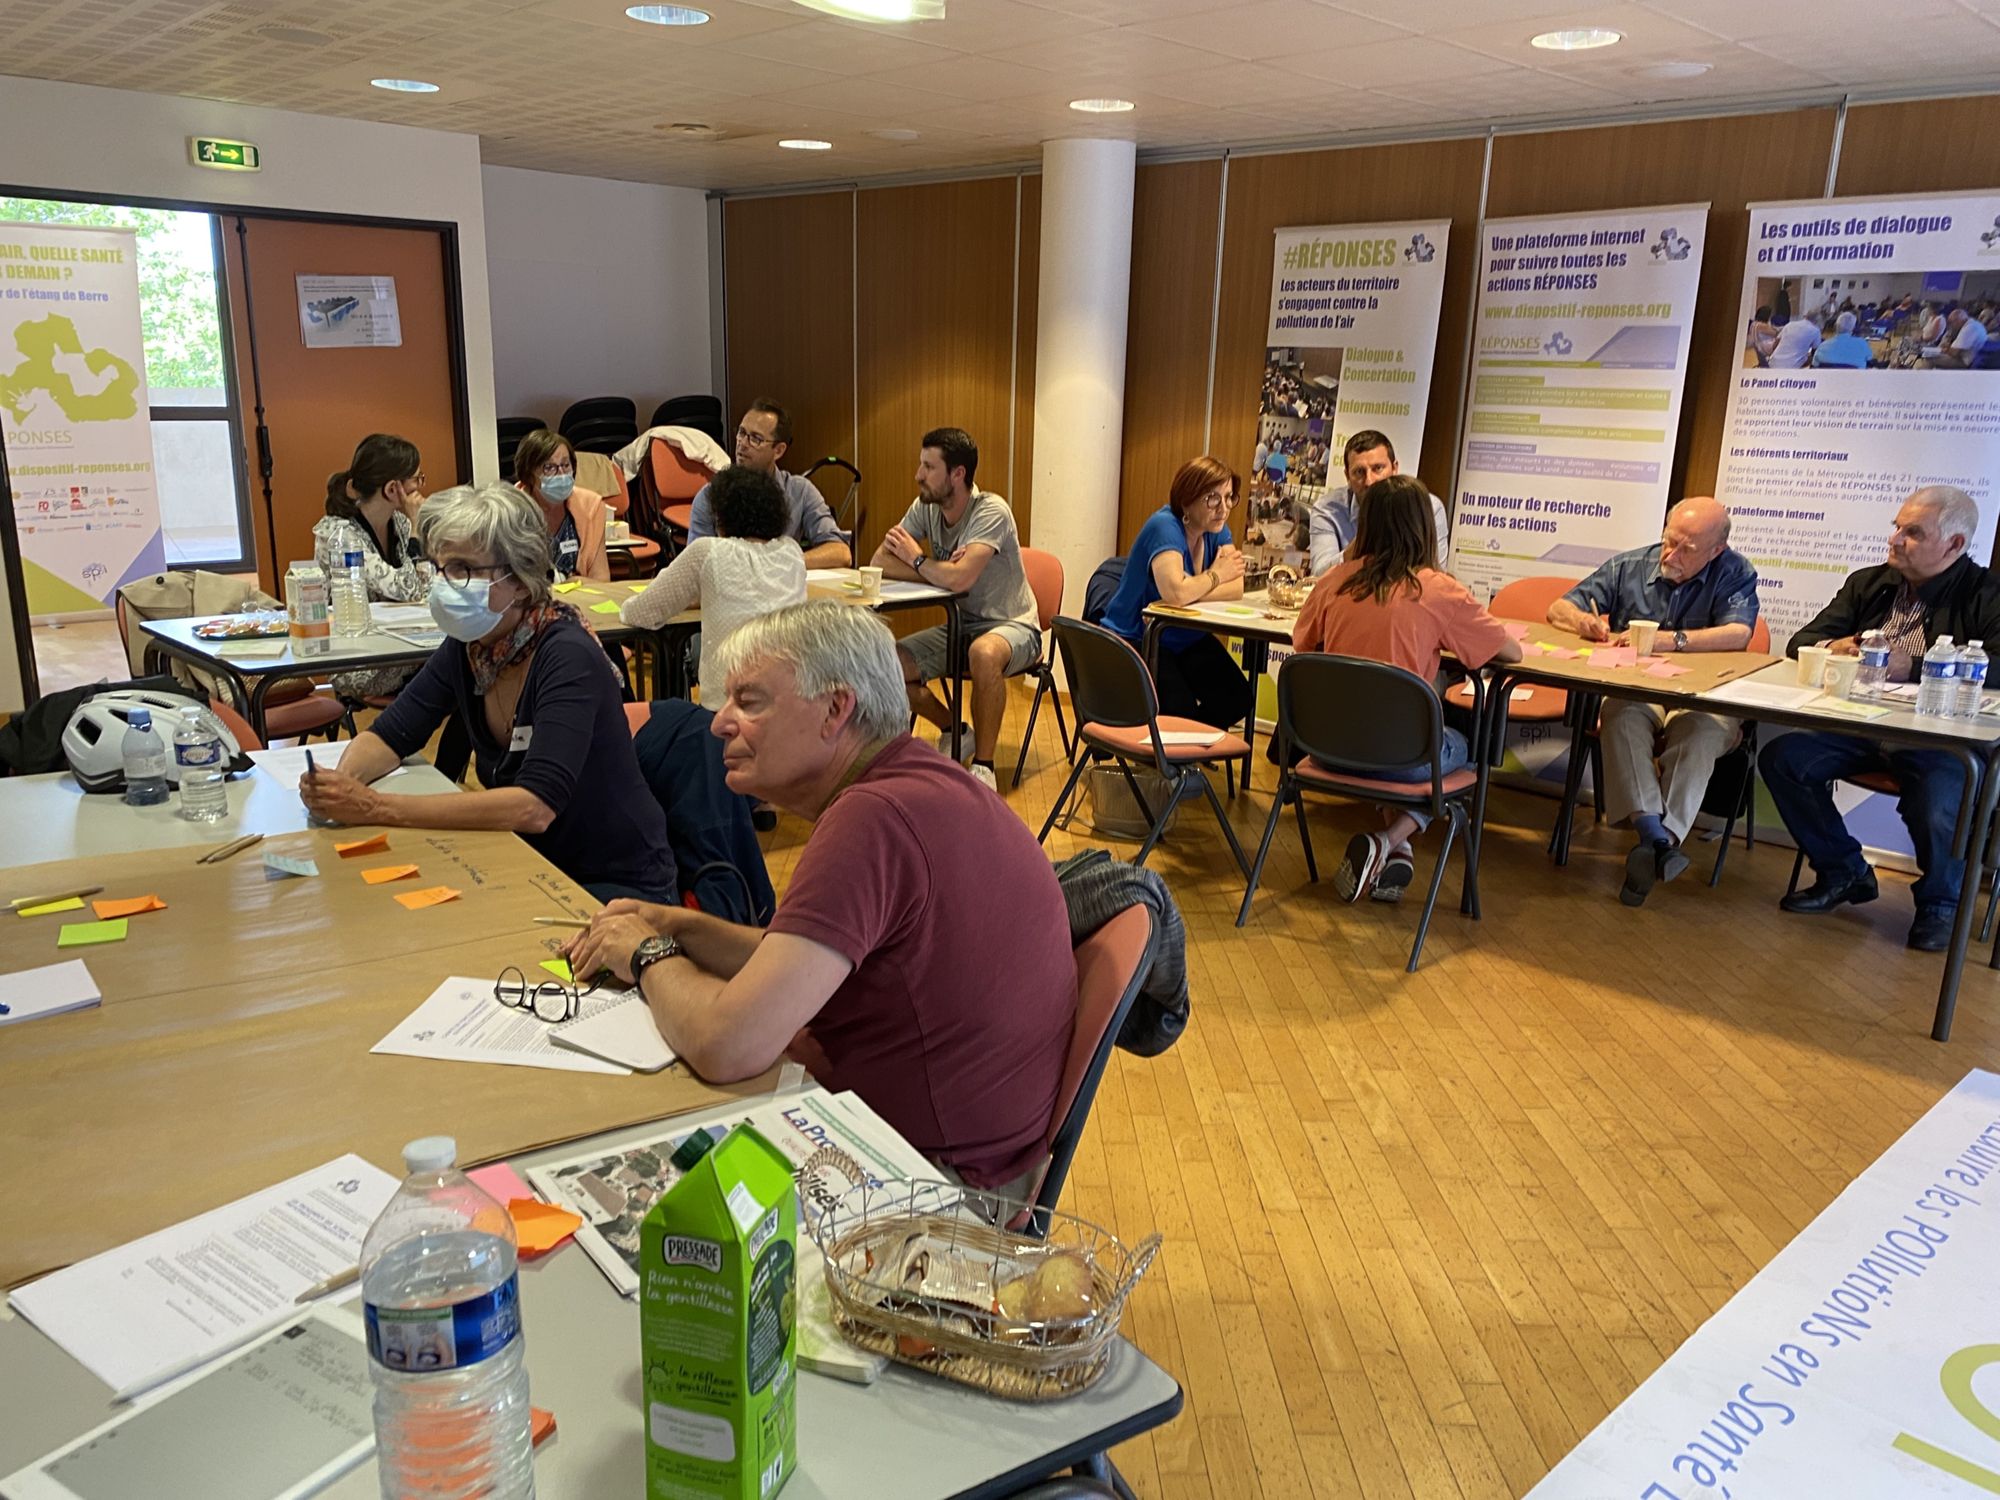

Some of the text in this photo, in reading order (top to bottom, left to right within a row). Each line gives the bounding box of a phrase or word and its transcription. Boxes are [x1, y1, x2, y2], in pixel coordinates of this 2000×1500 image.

[1761, 215, 1952, 240] Les outils de dialogue
[1492, 229, 1646, 251] Une plateforme internet
[30, 245, 78, 262] QUELLE
[81, 247, 123, 263] SANTÉ
[1284, 238, 1397, 269] #RÉPONSES
[1757, 242, 1895, 262] et d'information
[1490, 251, 1627, 273] pour suivre toutes les
[6, 264, 73, 281] DEMAIN ?
[1281, 276, 1399, 292] Les acteurs du territoire
[1487, 273, 1598, 292] actions RÉPONSES
[6, 288, 109, 302] de l'étang de Berre
[1278, 296, 1378, 311] s'engagent contre la
[1484, 303, 1672, 320] www.dispositif-reponses.org
[1276, 315, 1355, 329] pollution de l'air
[1480, 334, 1540, 349] RÉPONSES
[1346, 348, 1394, 363] Dialogue
[1344, 366, 1416, 383] Concertation
[1740, 378, 1816, 390] Le Panel citoyen
[1338, 399, 1410, 416] Informations
[1751, 398, 1797, 407] personnes
[1801, 398, 1852, 408] volontaires
[1869, 399, 1916, 409] bénévoles
[1920, 401, 1985, 410] représentent
[1778, 408, 1799, 416] dans
[1802, 409, 1826, 417] toute
[1829, 409, 1846, 418] leur
[1903, 411, 1941, 420] suivent
[1945, 412, 1959, 421] les
[1744, 419, 1789, 429] apportent
[1792, 419, 1811, 427] leur
[1814, 420, 1842, 429] vision
[1845, 421, 1857, 429] de
[1859, 421, 1893, 430] terrain
[1896, 423, 1911, 431] sur
[1730, 447, 1849, 461] Les référents territoriaux
[1792, 469, 1803, 477] de
[1817, 469, 1864, 480] Métropole
[1867, 472, 1876, 480] et
[1880, 472, 1897, 481] des
[1756, 478, 1793, 487] premier
[1797, 479, 1822, 488] relais
[1826, 480, 1837, 489] de
[1841, 481, 1891, 492] RÉPONSES
[1895, 485, 1911, 493] sur
[1780, 488, 1838, 499] informations
[1462, 491, 1612, 518] Un moteur de recherche
[1732, 506, 1784, 518] plateforme
[1786, 509, 1825, 521] internet
[1459, 513, 1557, 533] pour les actions
[1735, 525, 1858, 541] présente le dispositif et les
[1751, 536, 1762, 544] de
[1766, 537, 1810, 547] recherche
[1814, 540, 1847, 551] permet
[1851, 542, 1862, 551] de
[1770, 547, 1778, 556] et
[1781, 548, 1792, 556] de
[1795, 550, 1822, 559] suivre
[1825, 551, 1842, 560] leur
[781, 1107, 808, 1130] La
[1915, 1183, 1981, 1218] les
[667, 1239, 719, 1266] PRESSADE
[648, 1269, 678, 1286] Rien
[666, 1290, 735, 1316] gentillesse
[1761, 1343, 1820, 1387] en
[1672, 1383, 1796, 1500] Santé
